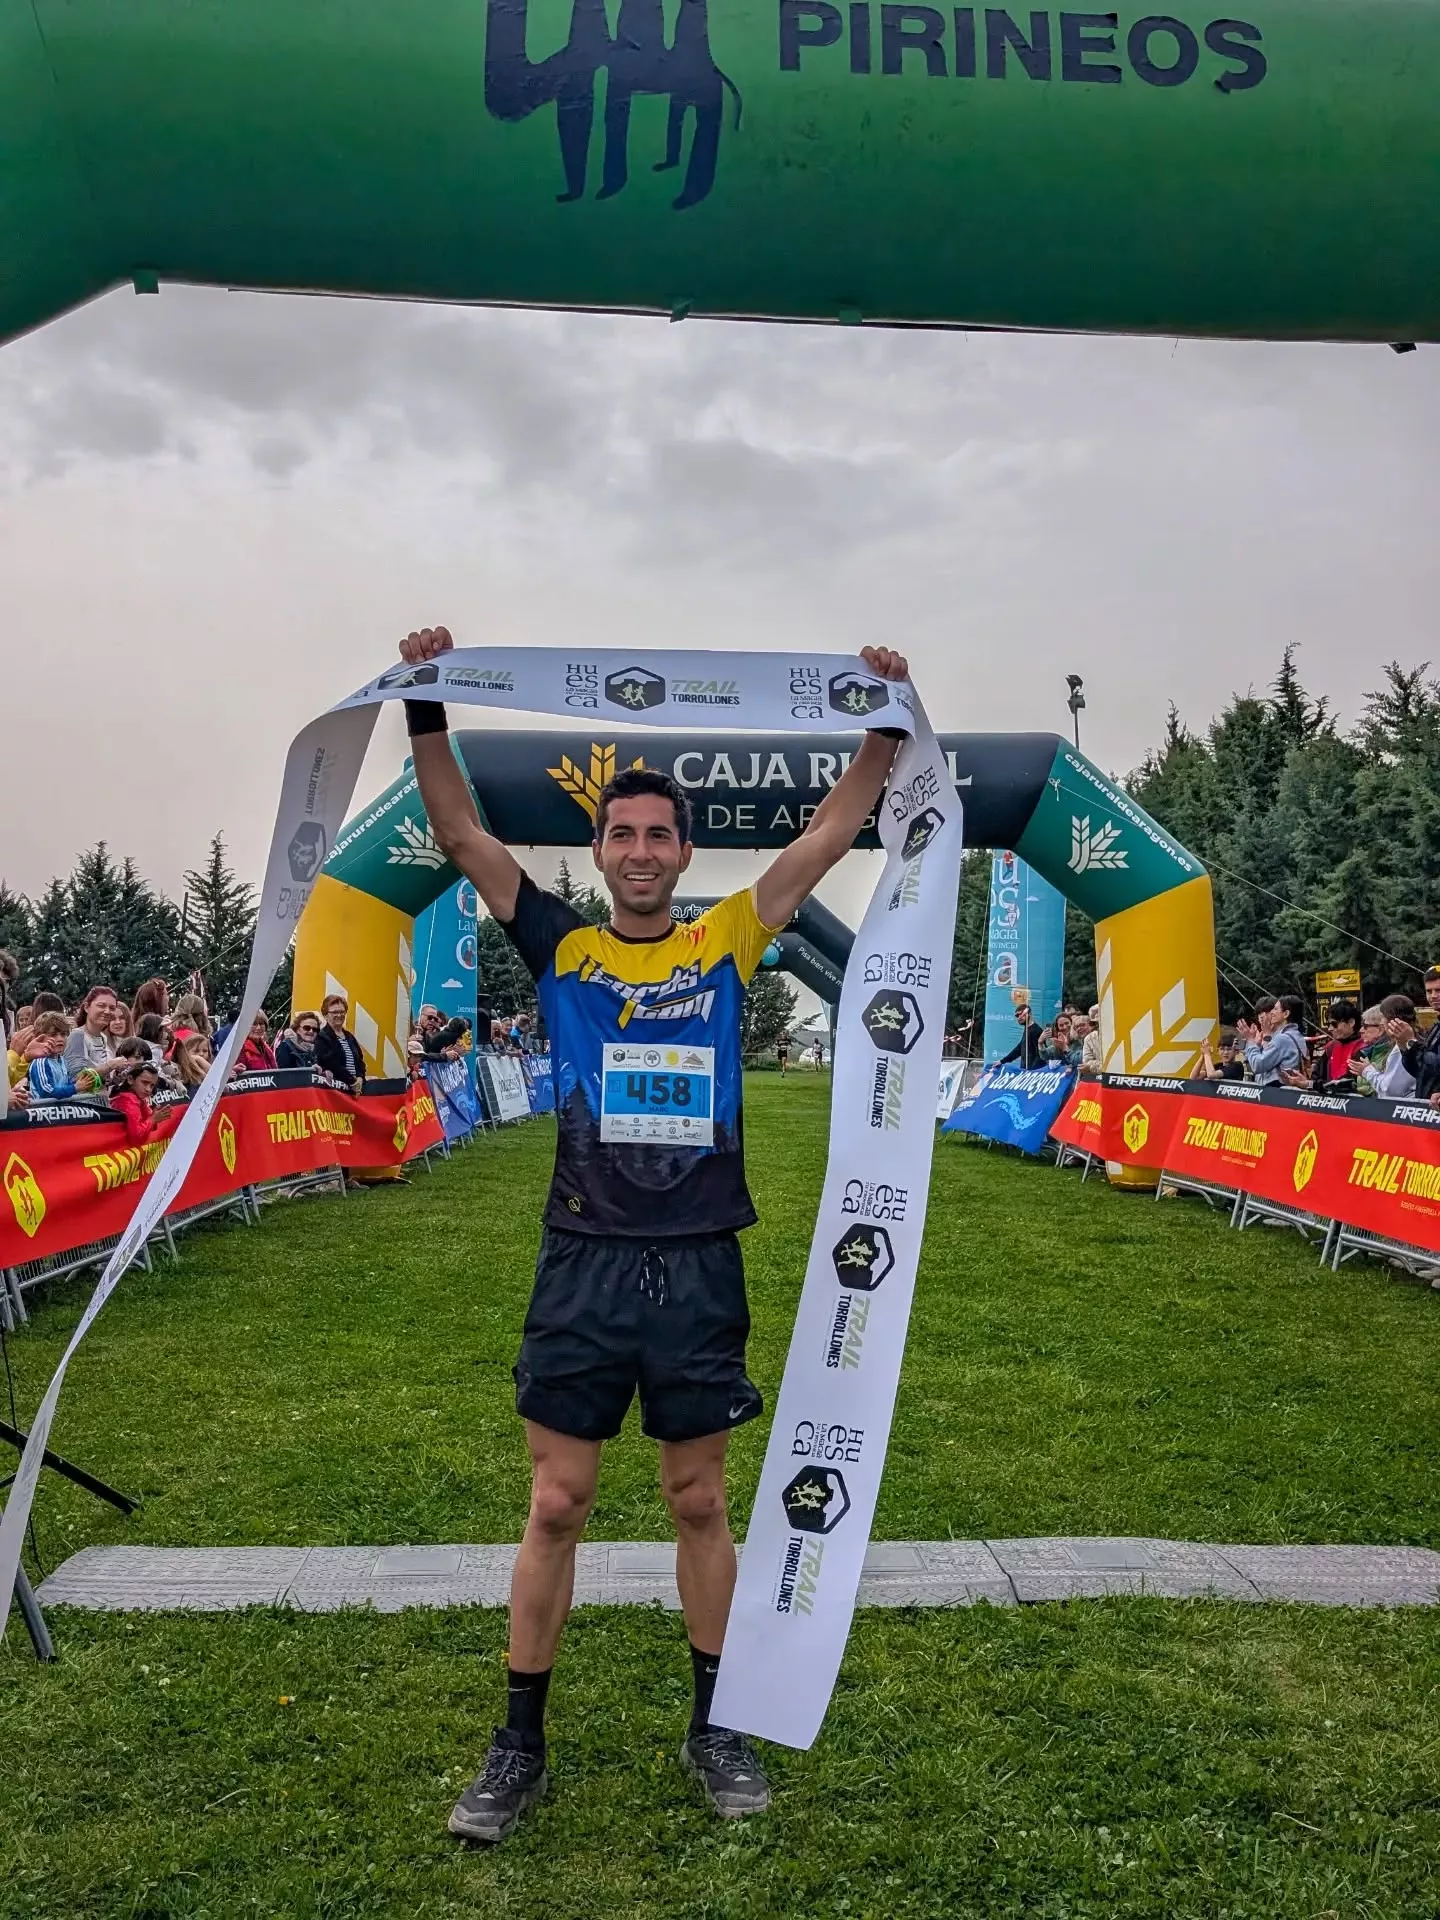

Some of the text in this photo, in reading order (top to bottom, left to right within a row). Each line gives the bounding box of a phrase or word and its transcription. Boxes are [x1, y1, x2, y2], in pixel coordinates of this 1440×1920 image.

[778, 1, 1268, 94] PIRINEOS
[443, 666, 515, 683] TRAIL
[443, 678, 515, 692] TORROLLONES
[670, 679, 741, 694] TRAIL
[671, 693, 741, 705] TORROLLONES
[672, 752, 789, 789] CAJA
[323, 776, 419, 865] ajaruraldearag
[707, 805, 756, 830] DE
[1064, 752, 1193, 873] cajaruraldearagon.es
[626, 1074, 692, 1107] 458
[870, 1056, 889, 1129] TORROLLONES
[885, 1058, 906, 1132] TRAIL
[1108, 1075, 1186, 1092] FIREHAWK
[1216, 1084, 1264, 1102] FIREHAWK
[1297, 1094, 1350, 1113] FIREHAWK
[28, 1105, 101, 1124] FIREHAWK
[266, 1109, 311, 1144] TRAIL
[1183, 1116, 1268, 1159] TRAIL TORROLLONES
[83, 1147, 141, 1193] TRAIL
[1347, 1147, 1440, 1202] TRAIL TORROL
[826, 1294, 852, 1369] TORROLLONES
[840, 1295, 871, 1371] TRAIL
[776, 1535, 804, 1614] TORROLLONES
[792, 1537, 825, 1617] TRAIL
